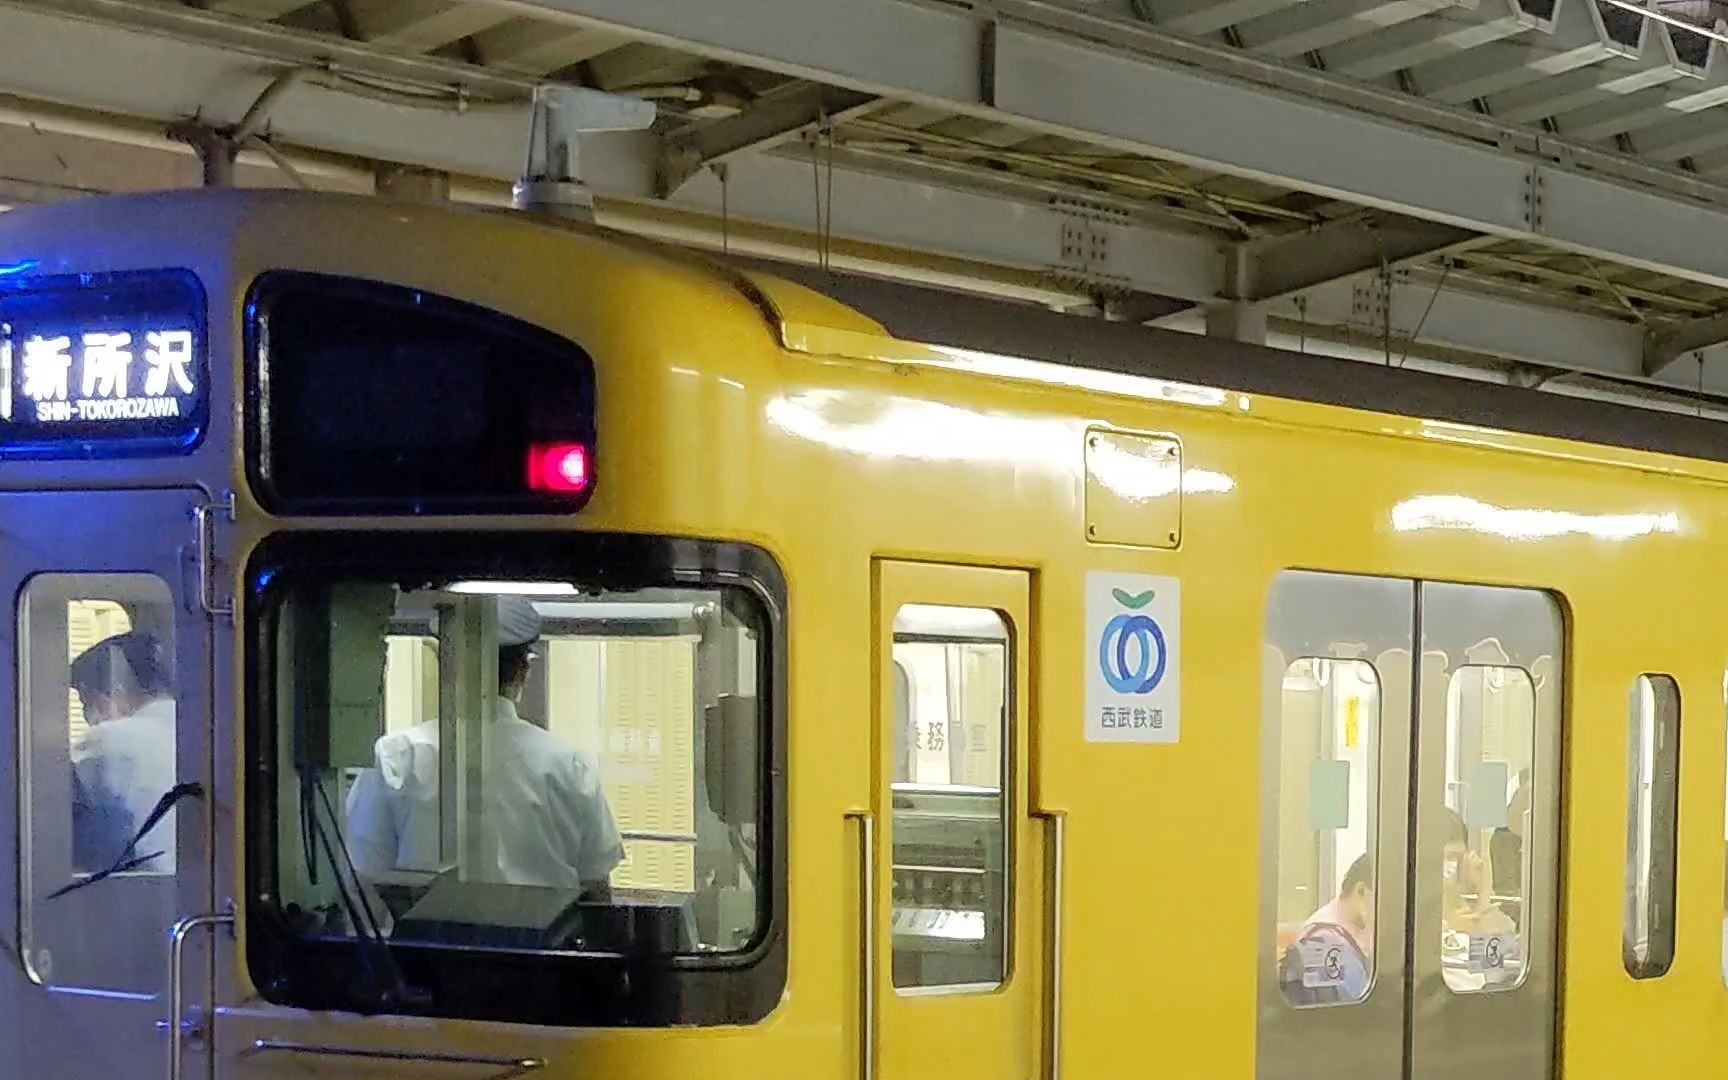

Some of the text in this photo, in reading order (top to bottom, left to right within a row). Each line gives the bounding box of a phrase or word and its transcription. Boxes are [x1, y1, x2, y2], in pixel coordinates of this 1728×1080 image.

[23, 331, 194, 400] 新所沢
[37, 398, 180, 421] SHIN-TOKOROZAWA
[1101, 707, 1163, 729] 西武鉄道
